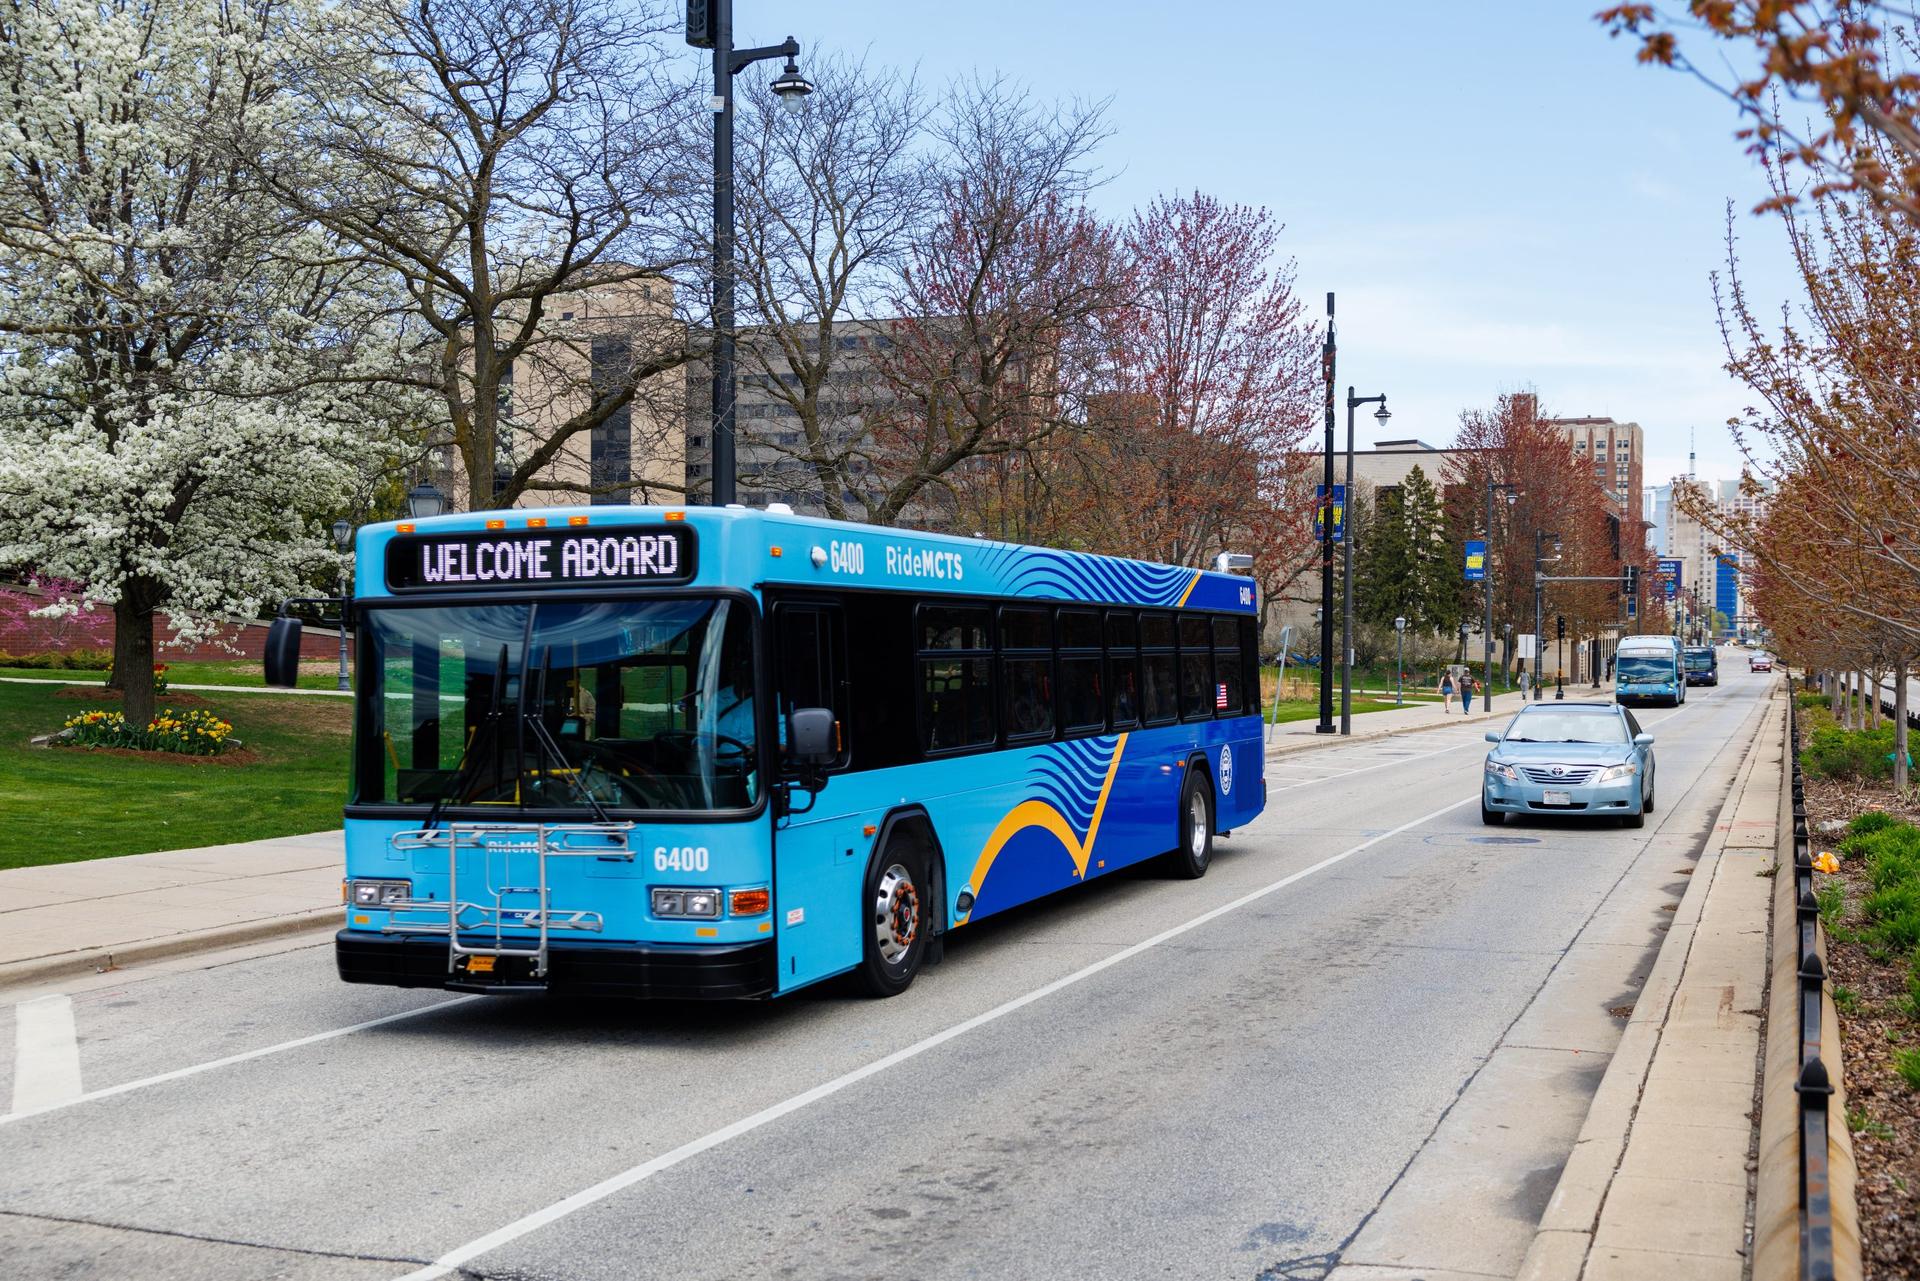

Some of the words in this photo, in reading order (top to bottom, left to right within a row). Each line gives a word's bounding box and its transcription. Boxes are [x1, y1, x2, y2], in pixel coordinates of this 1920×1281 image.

[424, 540, 552, 582] WELCOME
[562, 535, 678, 577] ABOARD
[830, 540, 865, 575] 6400
[886, 545, 963, 581] RideMCTS
[488, 840, 561, 854] RideMCS
[654, 846, 709, 872] 6400
